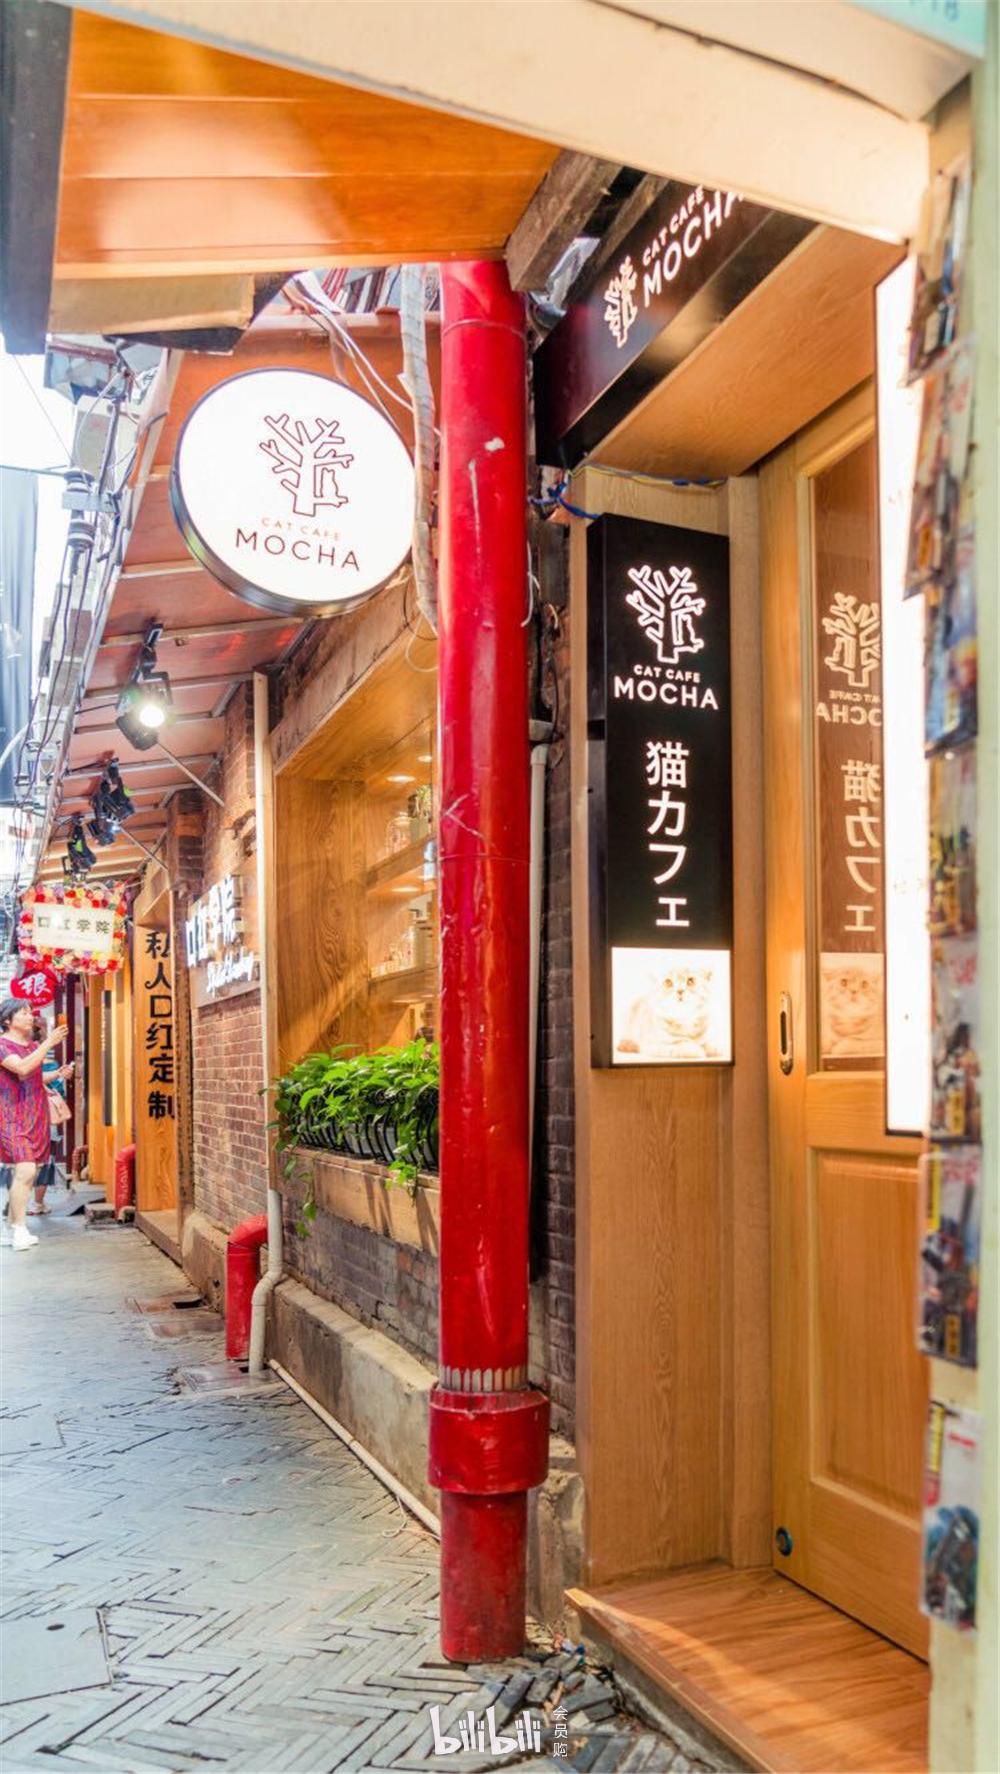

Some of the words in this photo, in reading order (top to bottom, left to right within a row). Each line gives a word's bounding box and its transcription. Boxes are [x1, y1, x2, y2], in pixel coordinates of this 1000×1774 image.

[643, 227, 668, 266] CAT
[669, 184, 704, 234] CAFE
[235, 528, 360, 571] MOCHA
[261, 518, 293, 531] CAT
[300, 525, 341, 542] CAFE
[613, 675, 719, 711] MOCHA
[633, 664, 662, 677] CAT
[665, 668, 701, 683] CAFE
[645, 741, 690, 928] 猫カフェ
[145, 931, 175, 1120] 私人口红定制
